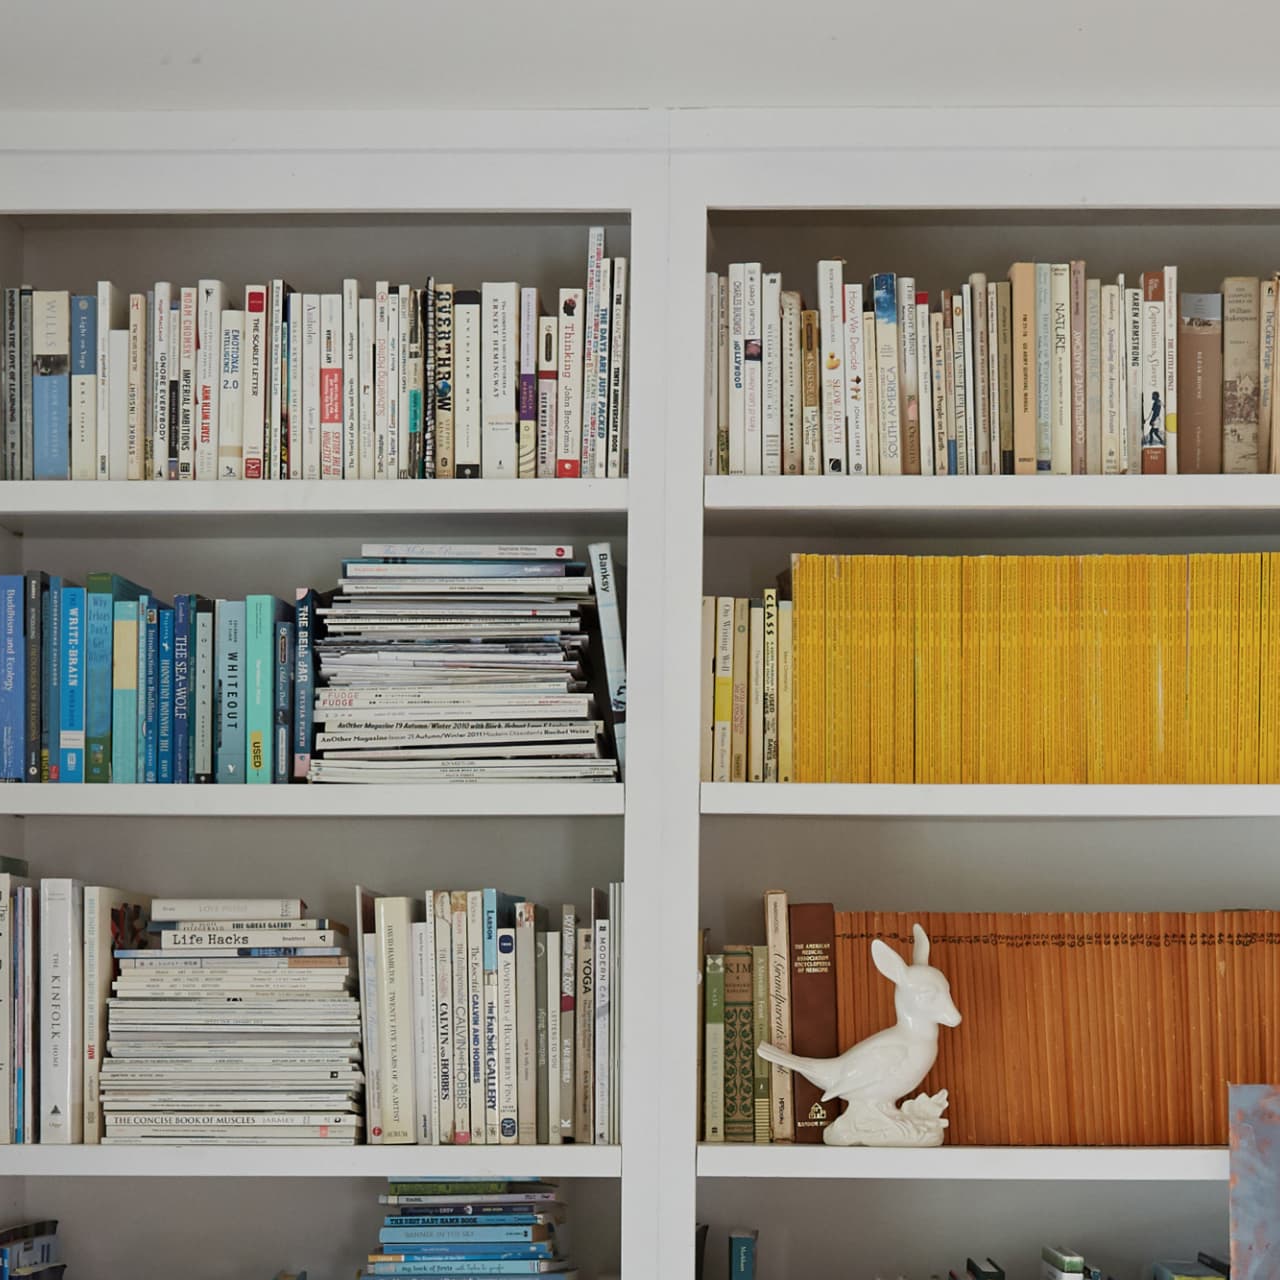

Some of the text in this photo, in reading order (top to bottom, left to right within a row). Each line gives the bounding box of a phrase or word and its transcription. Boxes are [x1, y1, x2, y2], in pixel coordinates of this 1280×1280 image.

[231, 329, 240, 374] EMOTIONAL
[251, 318, 260, 396] THE SCARLET LETTER
[436, 291, 451, 411] OVERTHROW
[849, 291, 858, 370] How We Decide
[1056, 303, 1065, 354] NATURE
[181, 292, 192, 451] NOAM CHOMSKY IMPERIAL AMBITIONS
[563, 323, 573, 454] Thinking John Brockman
[598, 553, 610, 593] Banksy
[5, 589, 16, 690] Buddhism and Ecology
[68, 607, 79, 686] WRITE-BRAIN
[175, 635, 187, 719] THE SEA-WOLF
[298, 606, 308, 682] THE BELL JAR
[228, 652, 237, 729] WHITEOUT
[253, 741, 261, 768] USED
[173, 934, 249, 945] Life Hacks
[582, 959, 591, 994] YOGA
[50, 975, 61, 1040] KINFOLK
